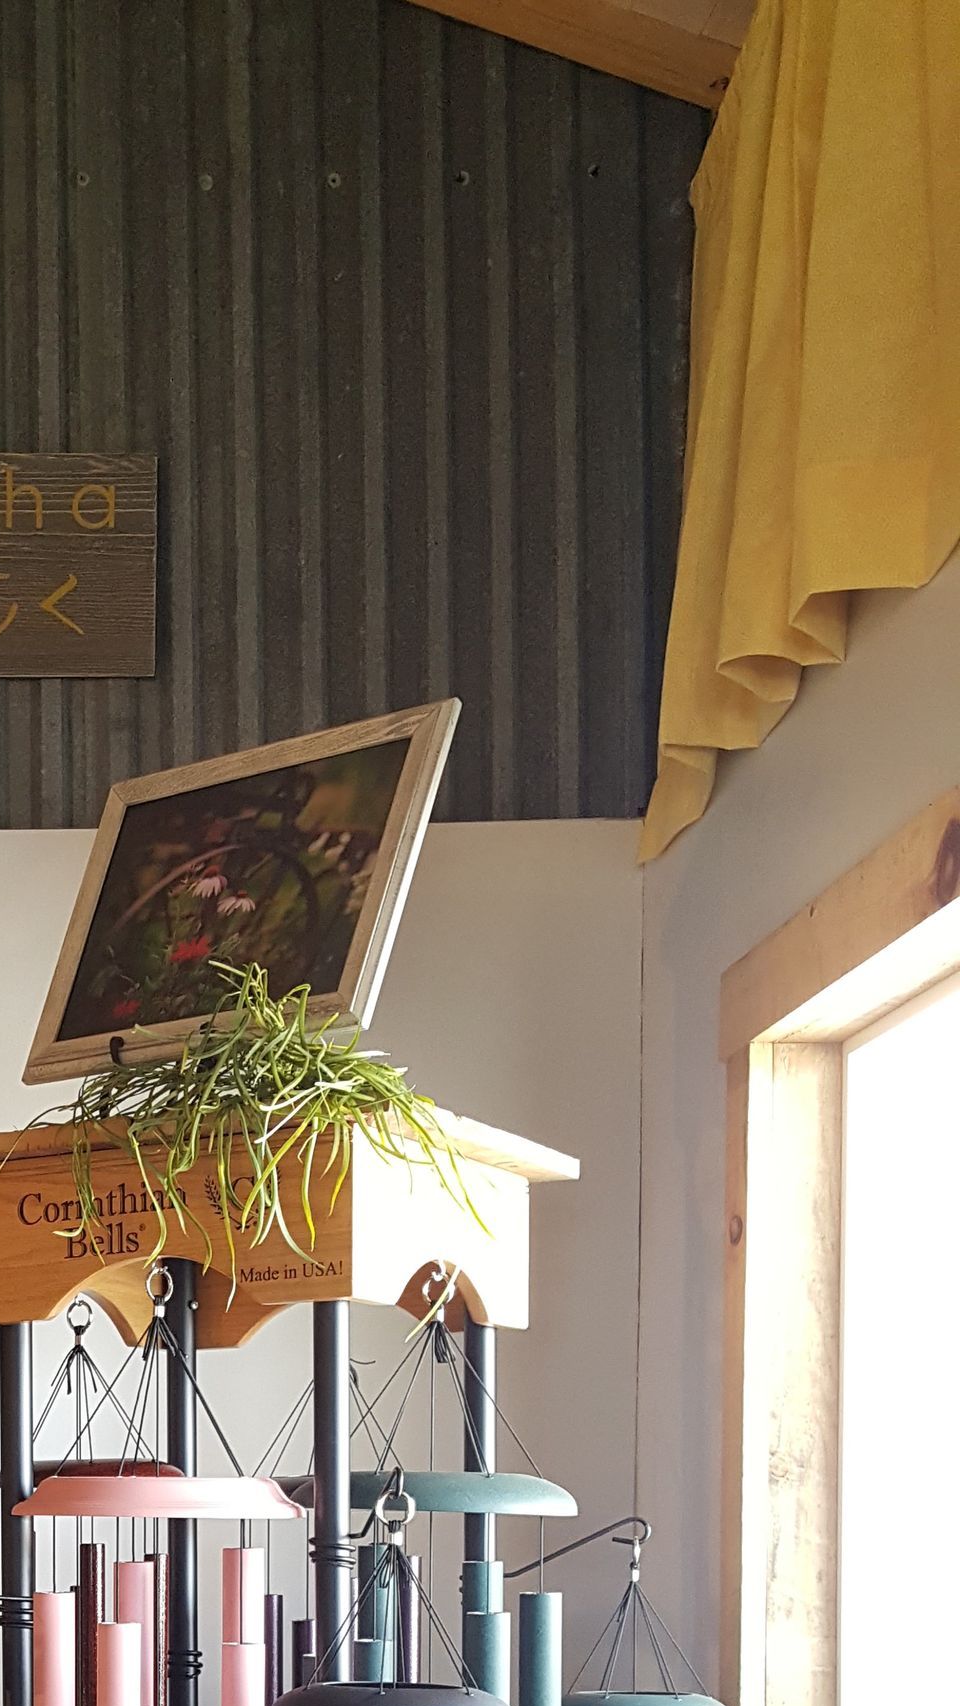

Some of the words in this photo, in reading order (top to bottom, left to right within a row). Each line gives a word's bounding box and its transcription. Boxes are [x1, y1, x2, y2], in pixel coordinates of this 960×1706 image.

[71, 484, 116, 530] a
[17, 1180, 190, 1227] Corinthian
[240, 1265, 280, 1283] Made
[283, 1264, 297, 1279] in
[302, 1260, 343, 1278] USA!
